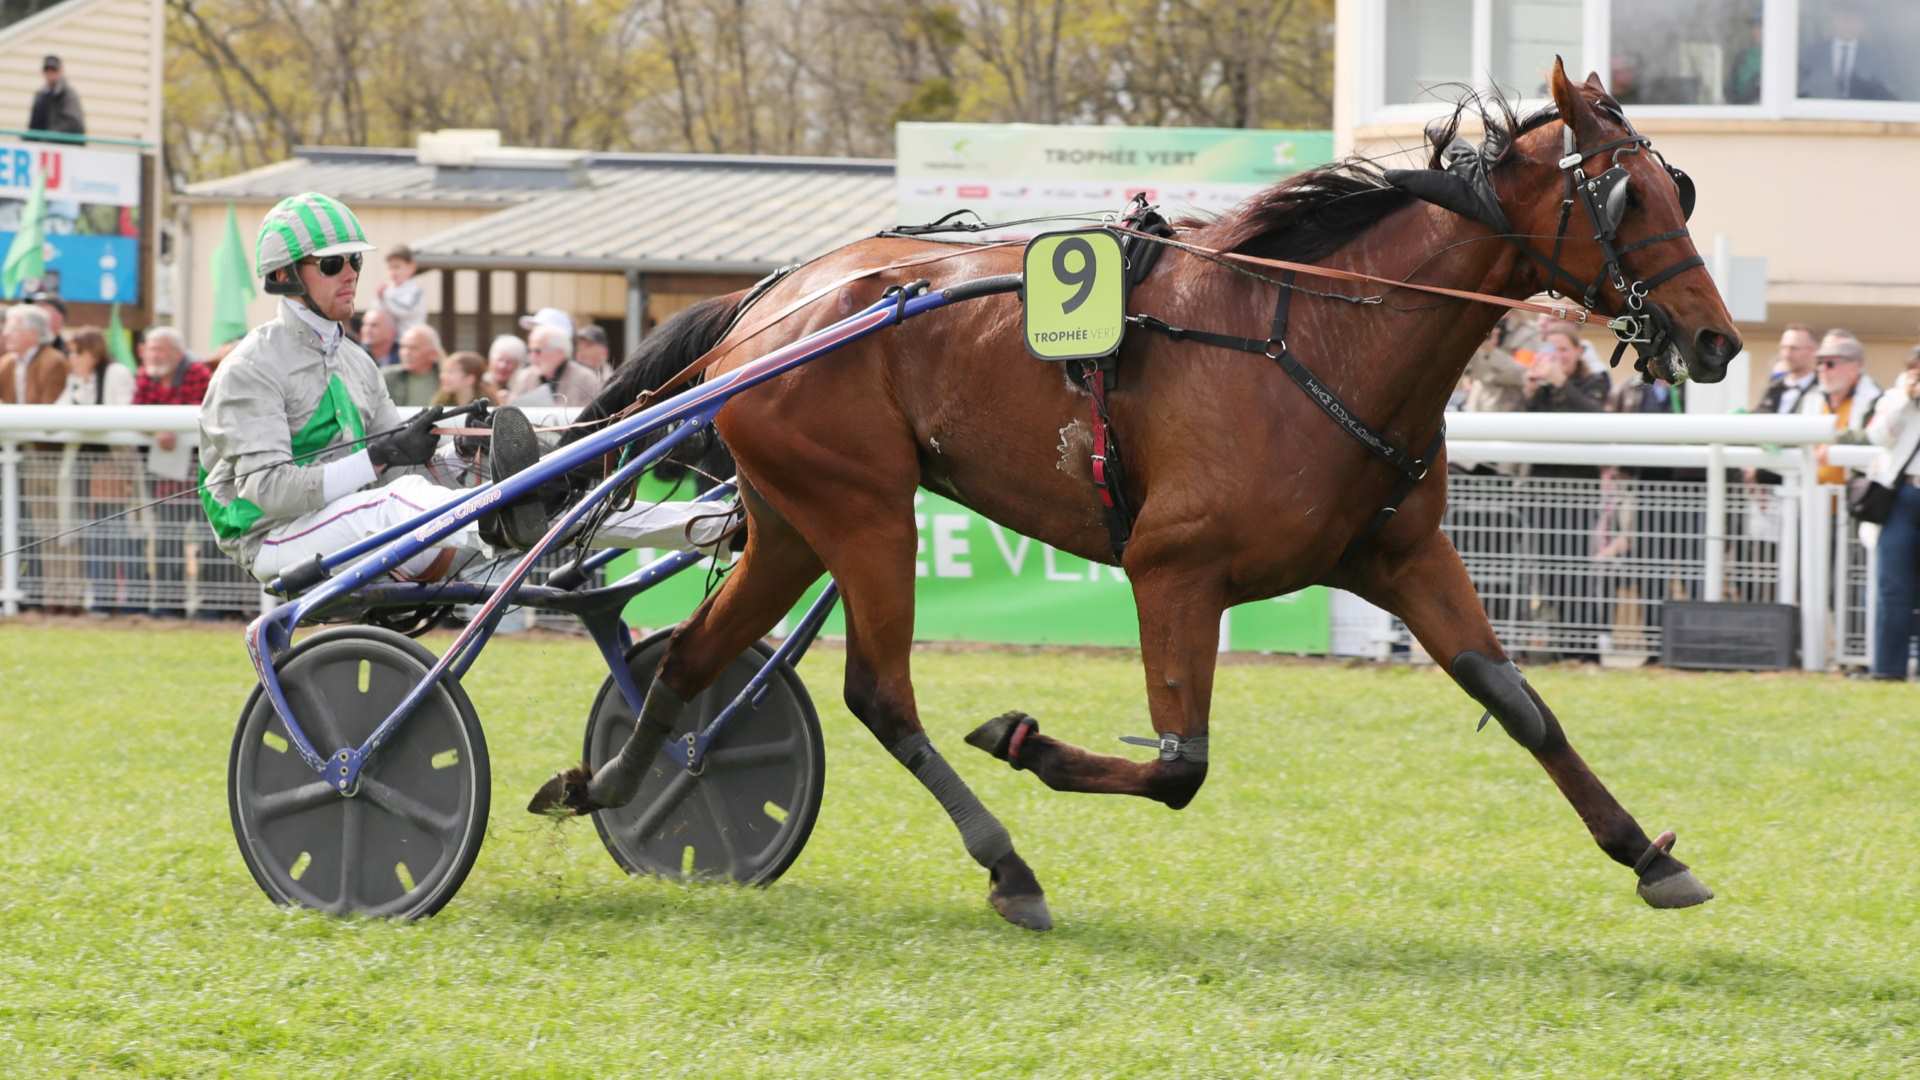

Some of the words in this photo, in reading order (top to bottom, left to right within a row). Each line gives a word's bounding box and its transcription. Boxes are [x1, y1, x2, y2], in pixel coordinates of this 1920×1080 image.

[1045, 145, 1137, 165] TROPHÉE
[1149, 150, 1198, 165] VERT
[1052, 237, 1097, 315] 9
[1034, 327, 1088, 343] TROPHÉE
[1091, 326, 1117, 339] VERT
